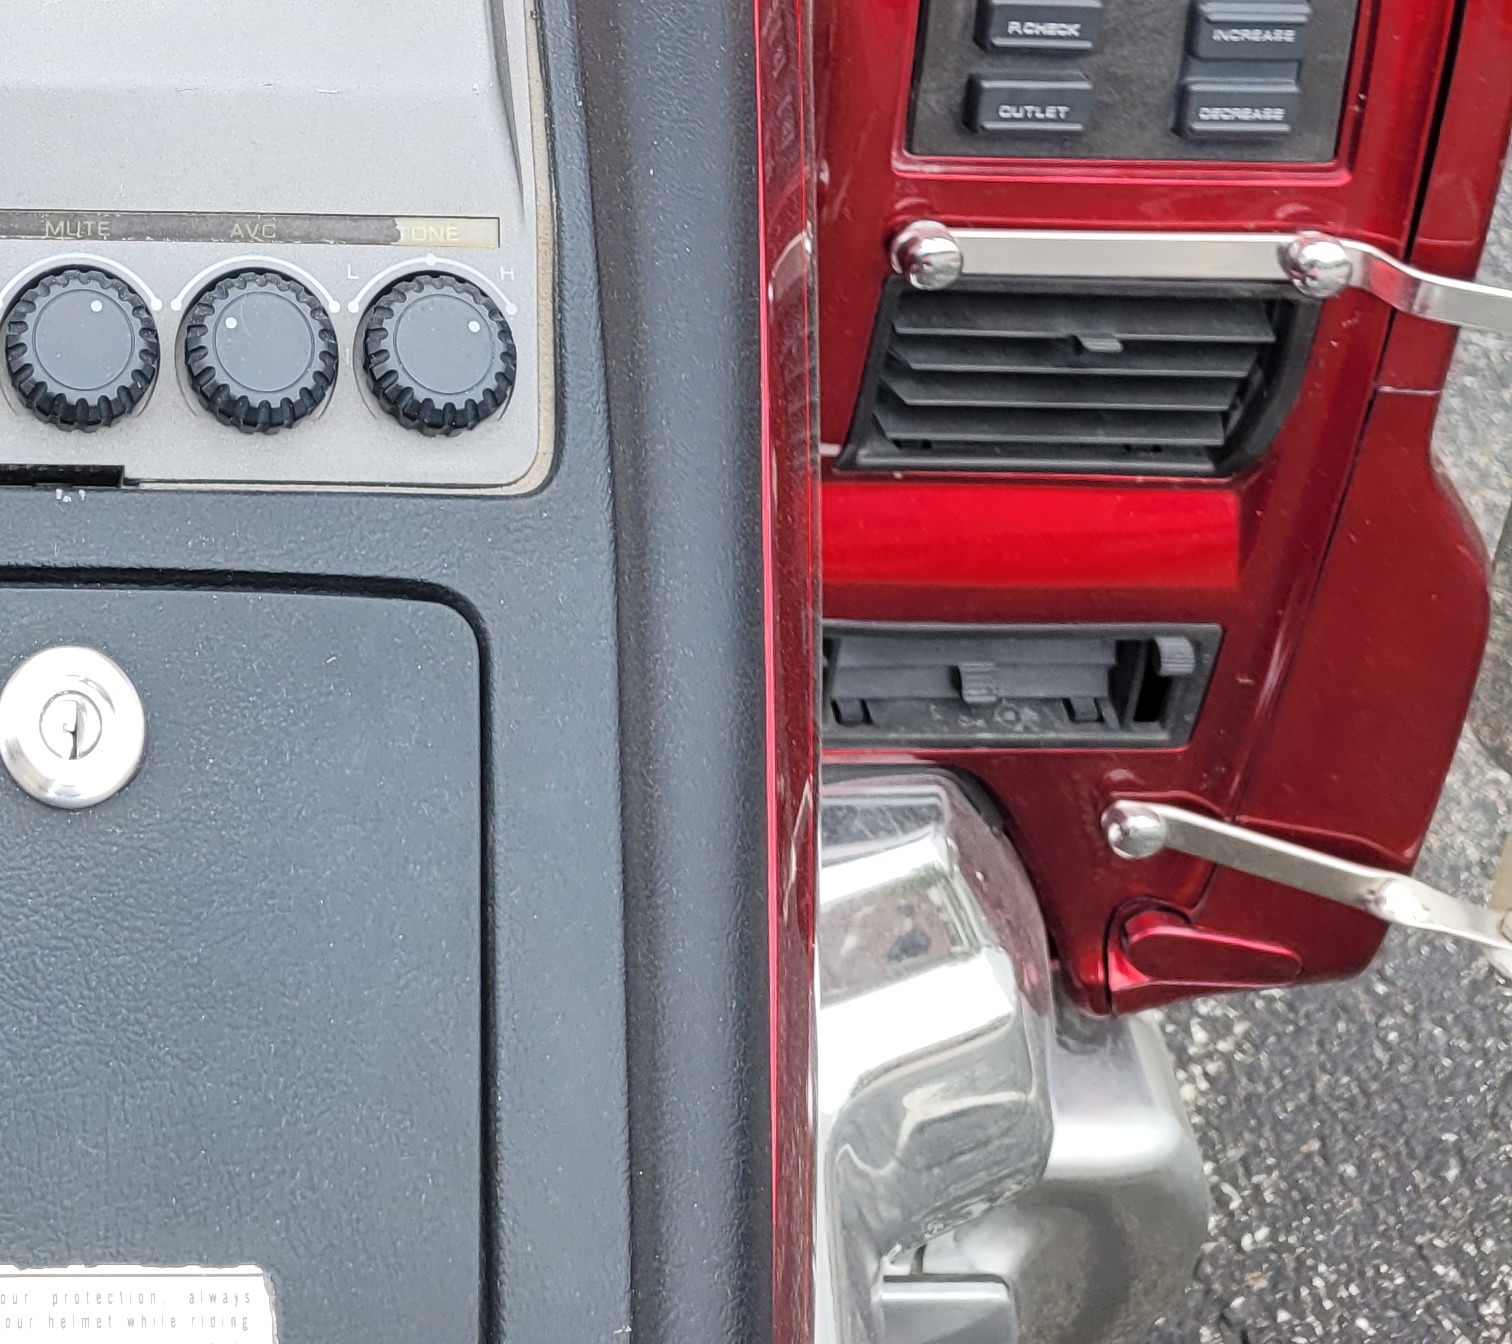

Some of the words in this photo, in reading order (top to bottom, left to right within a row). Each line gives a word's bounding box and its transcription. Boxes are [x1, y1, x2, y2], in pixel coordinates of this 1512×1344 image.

[1211, 28, 1296, 43] INCREASE
[998, 104, 1070, 120] OUTLET
[1198, 106, 1286, 121] DECREASE
[44, 219, 110, 237] MUTE
[229, 222, 277, 240] AVC
[347, 263, 360, 280] L
[500, 265, 516, 281] H
[189, 1289, 250, 1308] always
[48, 1313, 112, 1329] helmet
[127, 1312, 177, 1329] while
[191, 1315, 249, 1332] riding
